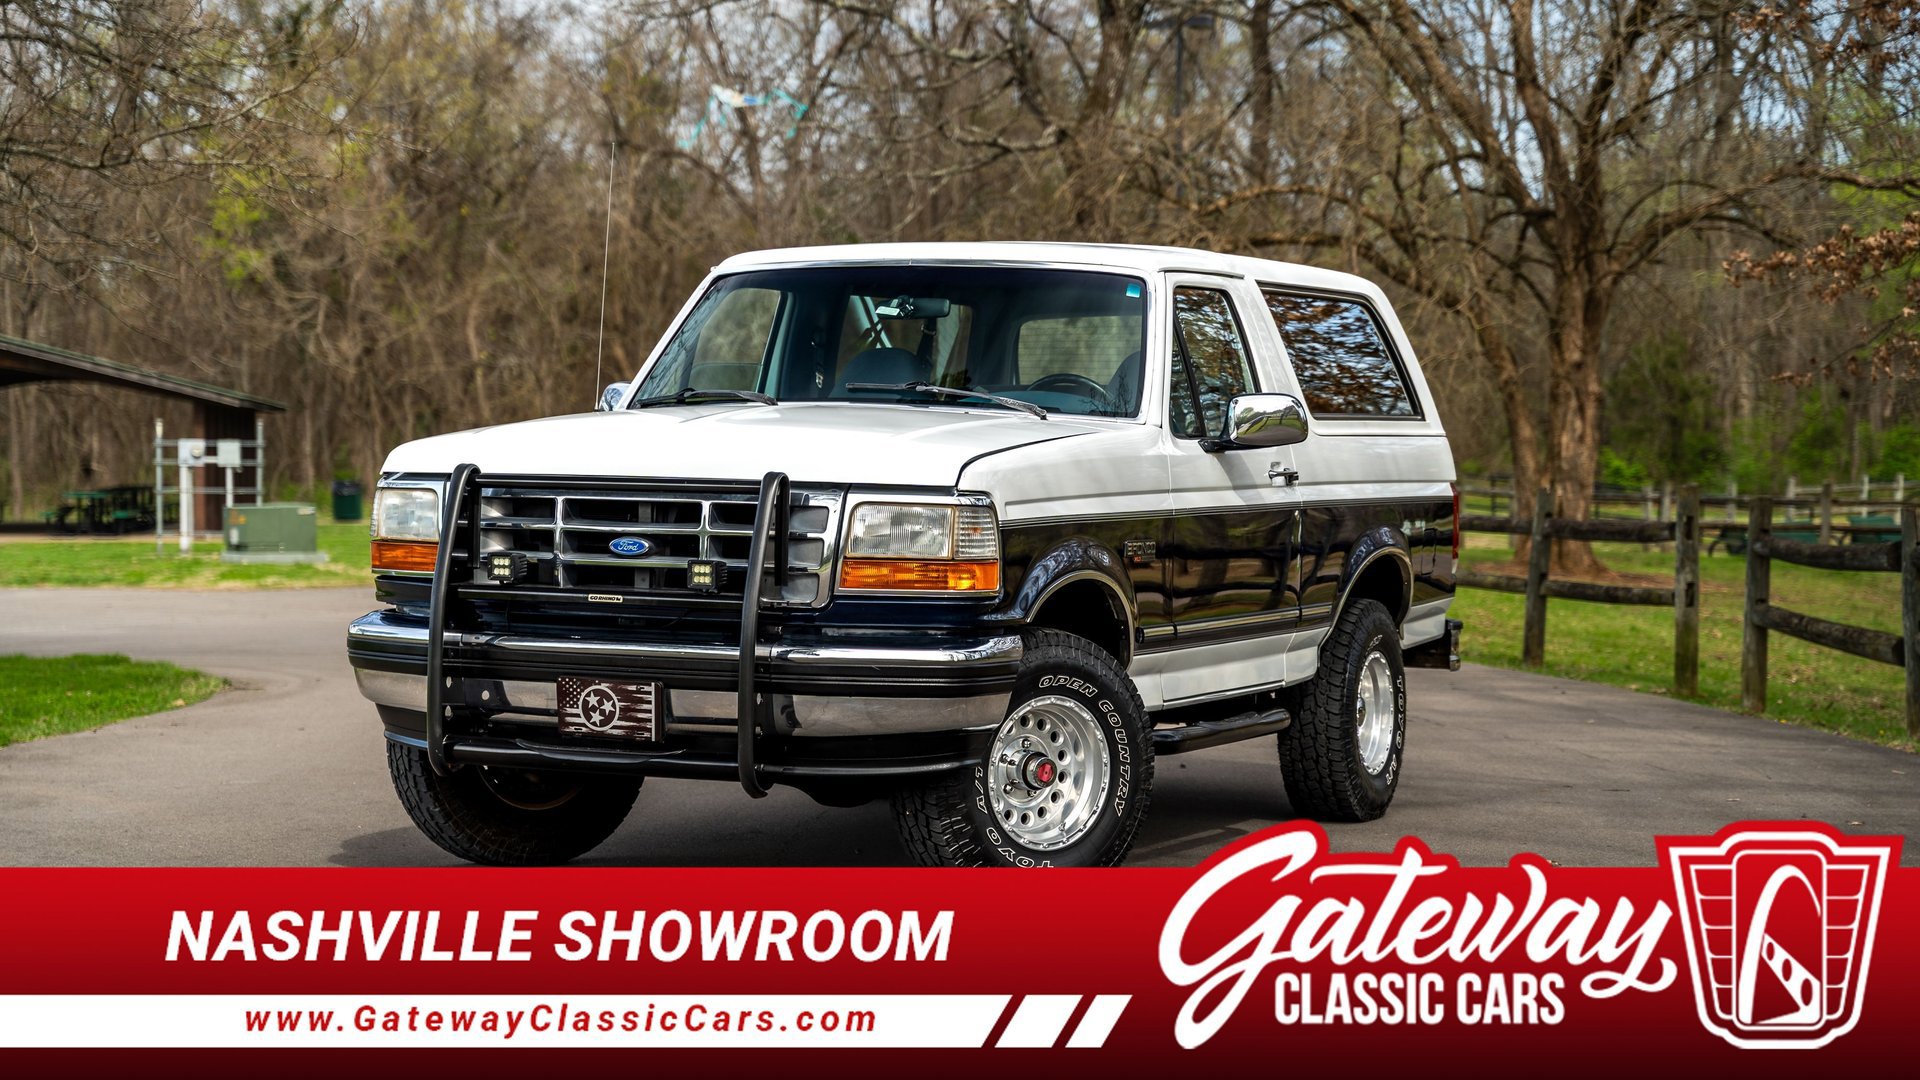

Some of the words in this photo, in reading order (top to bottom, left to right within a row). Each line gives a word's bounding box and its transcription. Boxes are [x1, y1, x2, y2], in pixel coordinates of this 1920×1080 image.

[617, 540, 639, 551] Ford
[1038, 675, 1098, 698] OPEN
[1098, 699, 1131, 817] COUNTRY
[975, 767, 988, 814] A/T
